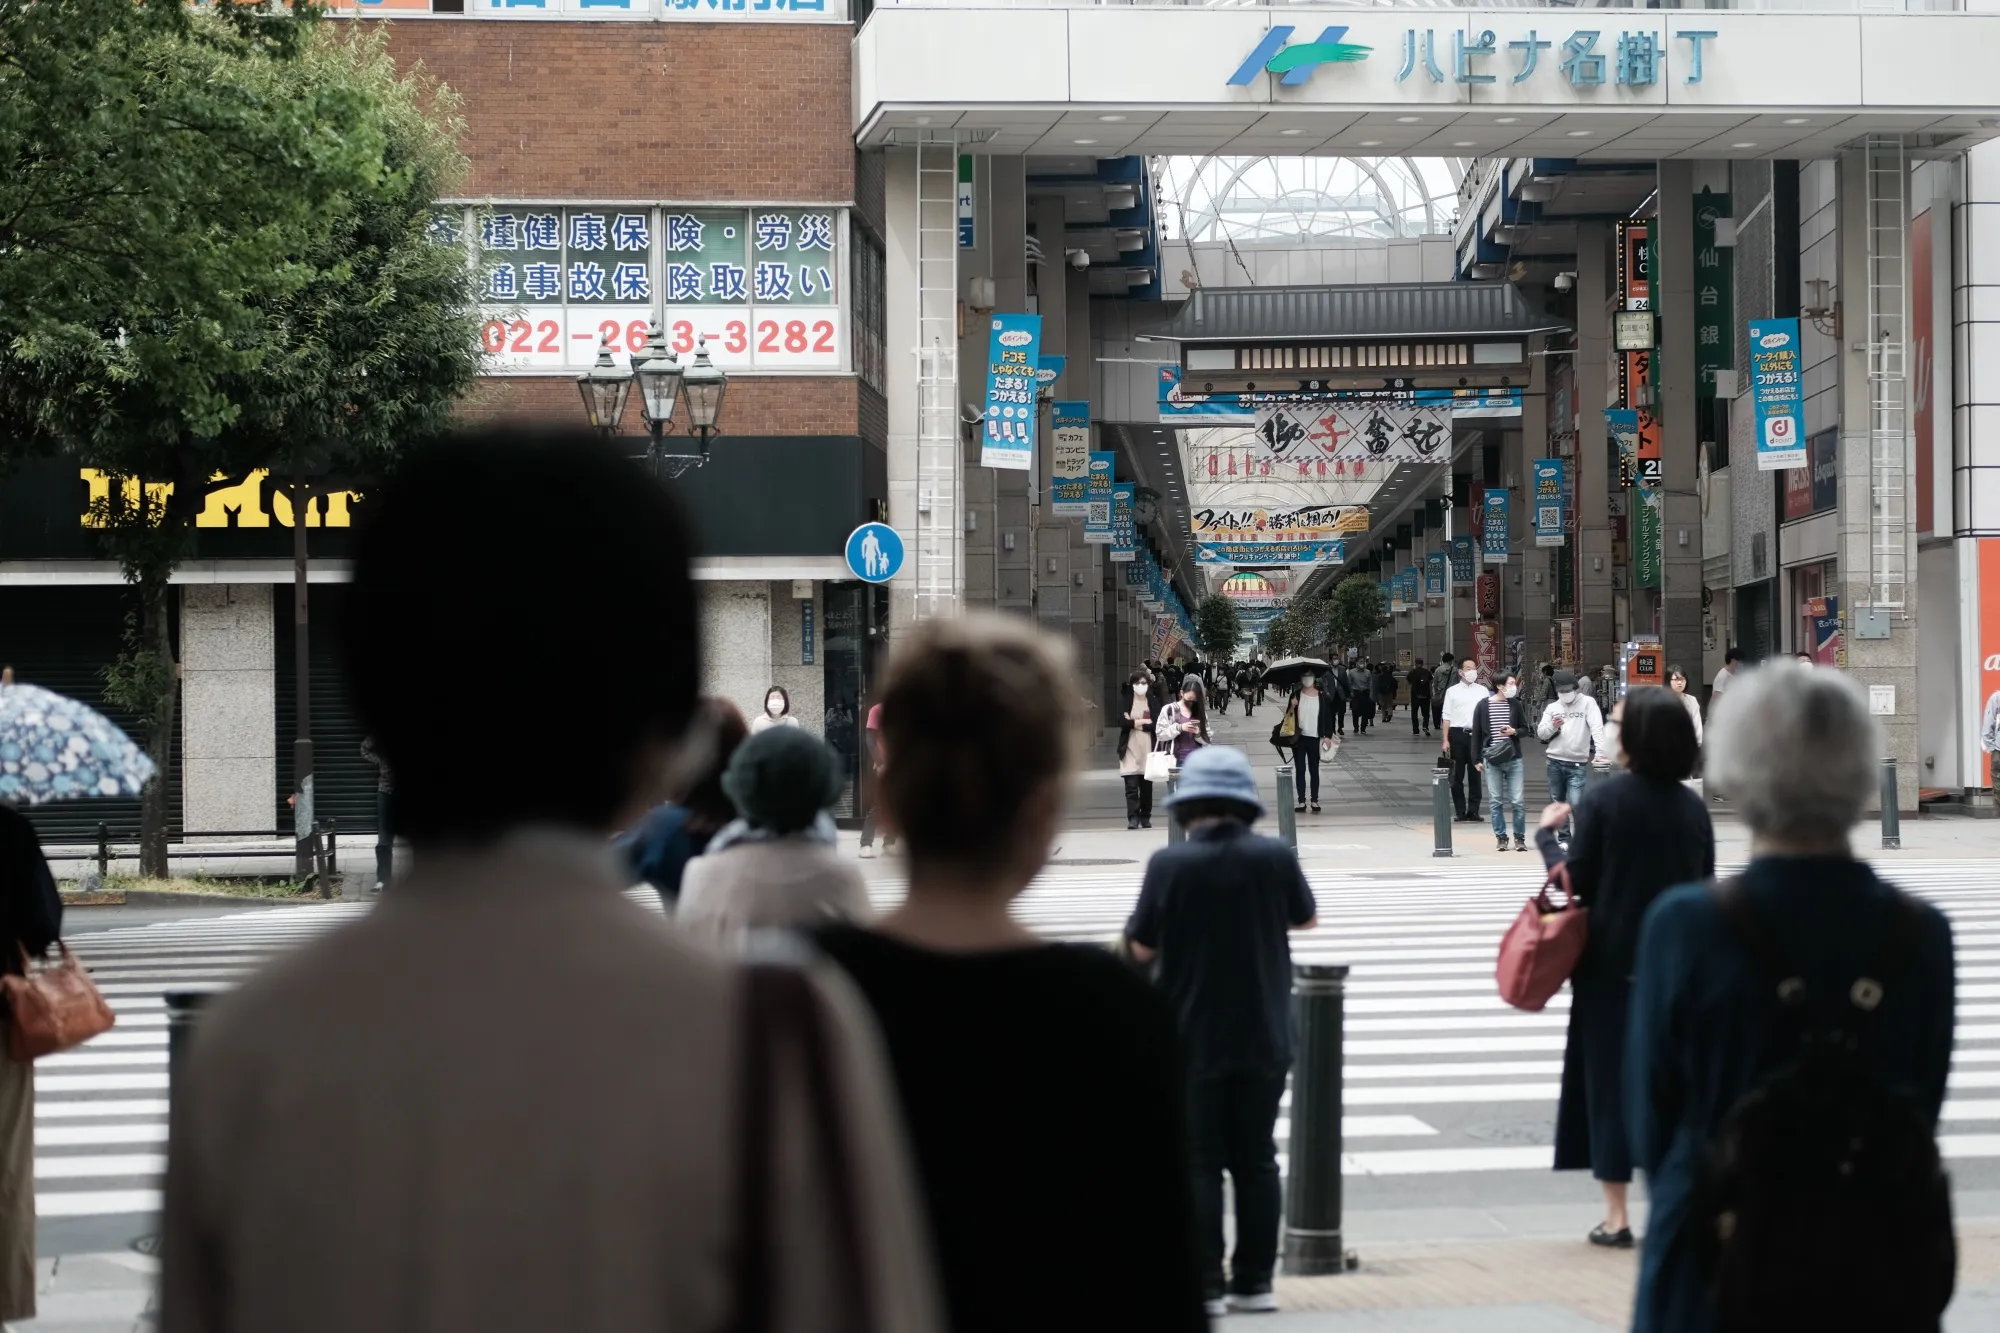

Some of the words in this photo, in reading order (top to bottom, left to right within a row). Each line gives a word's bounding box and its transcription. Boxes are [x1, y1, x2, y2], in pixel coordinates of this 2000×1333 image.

[1395, 29, 1717, 85] ハピナ名掛丁
[1699, 247, 1720, 384] 仙台銀行
[481, 319, 836, 354] 022-263-3282
[1001, 350, 1028, 364] ドコモ
[1754, 351, 1797, 363] ケータイ購入
[991, 364, 1035, 377] じゃなくても
[1759, 361, 1794, 371] 以外にも
[994, 376, 1029, 391] たまる!
[1756, 371, 1798, 385] つかえる!
[989, 390, 1032, 404] つかえる!
[1068, 434, 1083, 442] カフェ
[1065, 446, 1086, 454] コンビニ
[1539, 479, 1557, 487] たまる!
[1058, 490, 1085, 499] つかえる!
[1537, 486, 1560, 494] つかえる!
[1193, 508, 1253, 531] ファイト!!
